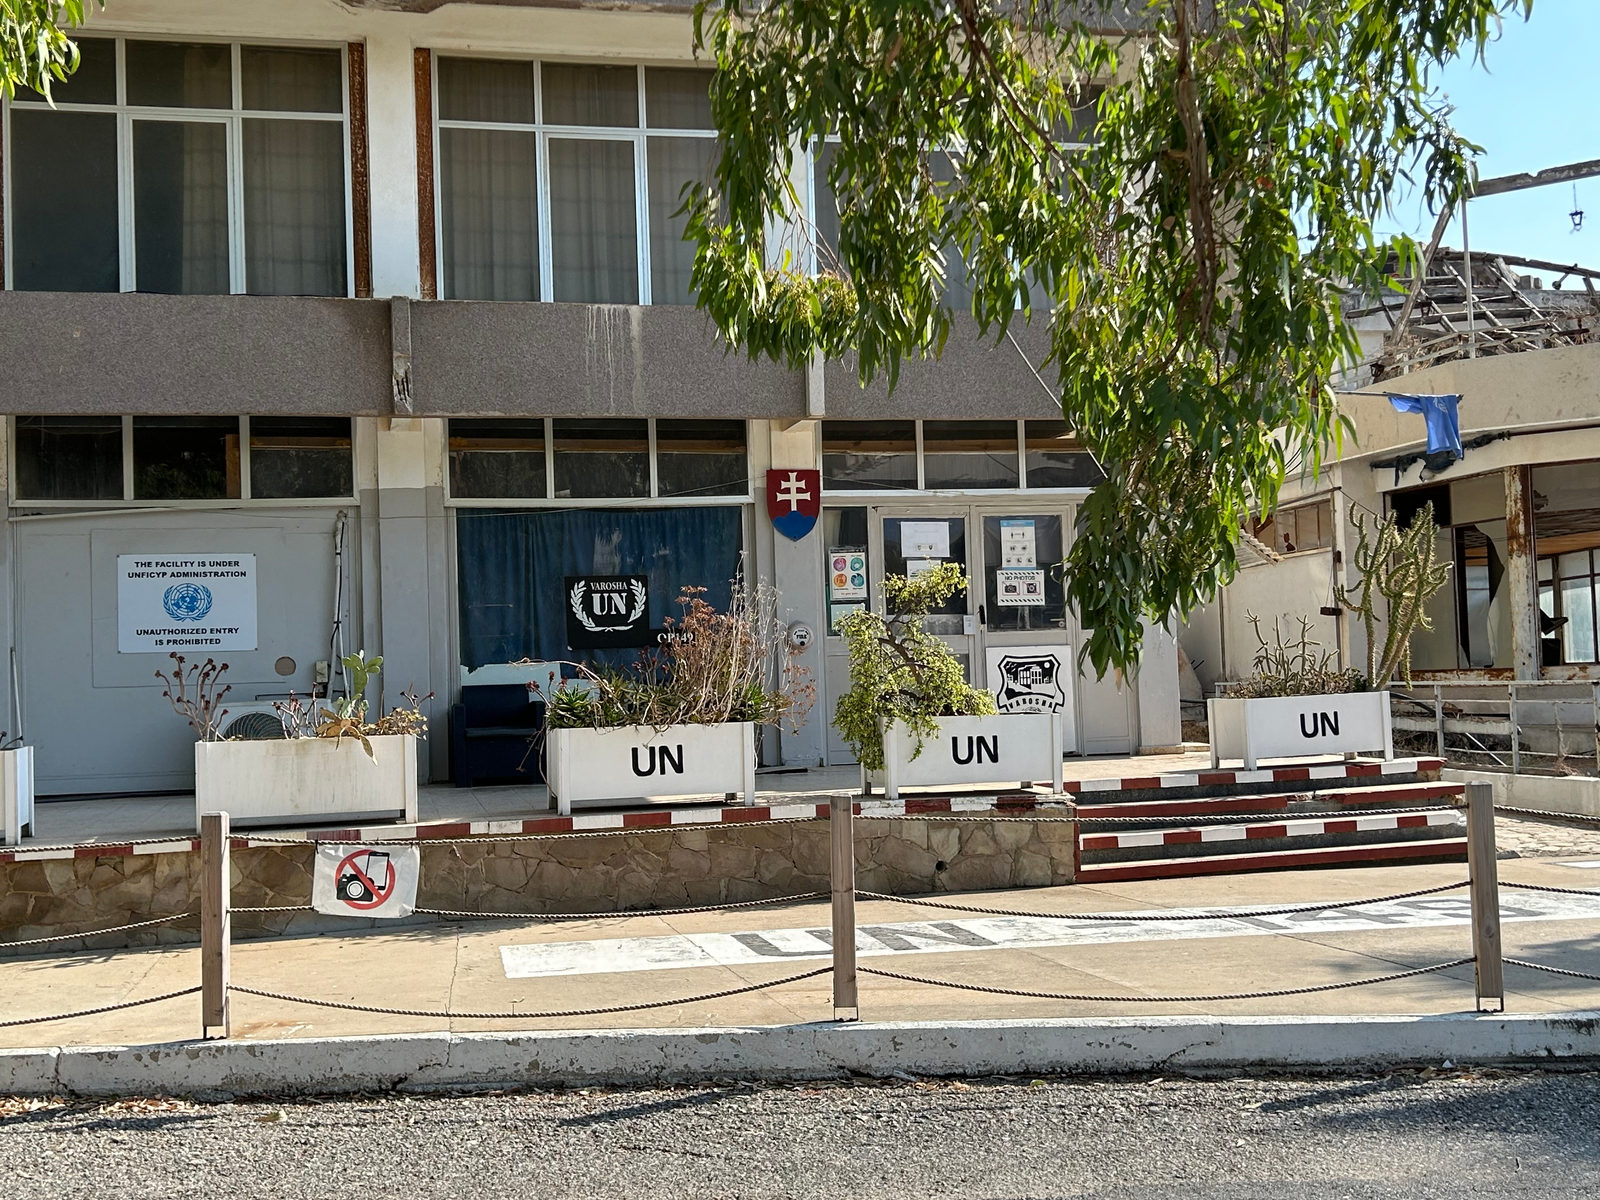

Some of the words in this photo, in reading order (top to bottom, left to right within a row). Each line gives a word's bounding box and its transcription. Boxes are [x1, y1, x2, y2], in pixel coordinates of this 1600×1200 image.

[155, 560, 195, 568] FACILITY
[198, 560, 206, 568] IS
[209, 560, 240, 568] UNDER
[170, 570, 247, 578] ADMINISTRATION
[590, 581, 628, 591] VAROSHA
[591, 592, 628, 616] UN
[136, 628, 207, 636] UNAUTHORIZED
[210, 627, 240, 635] ENTRY
[155, 639, 164, 647] IS
[166, 638, 221, 646] PROHIBITED
[1008, 698, 1054, 709] VAROSHA
[1299, 710, 1340, 739] UN
[951, 734, 999, 766] UN
[631, 744, 684, 777] UN
[731, 922, 999, 957] UN
